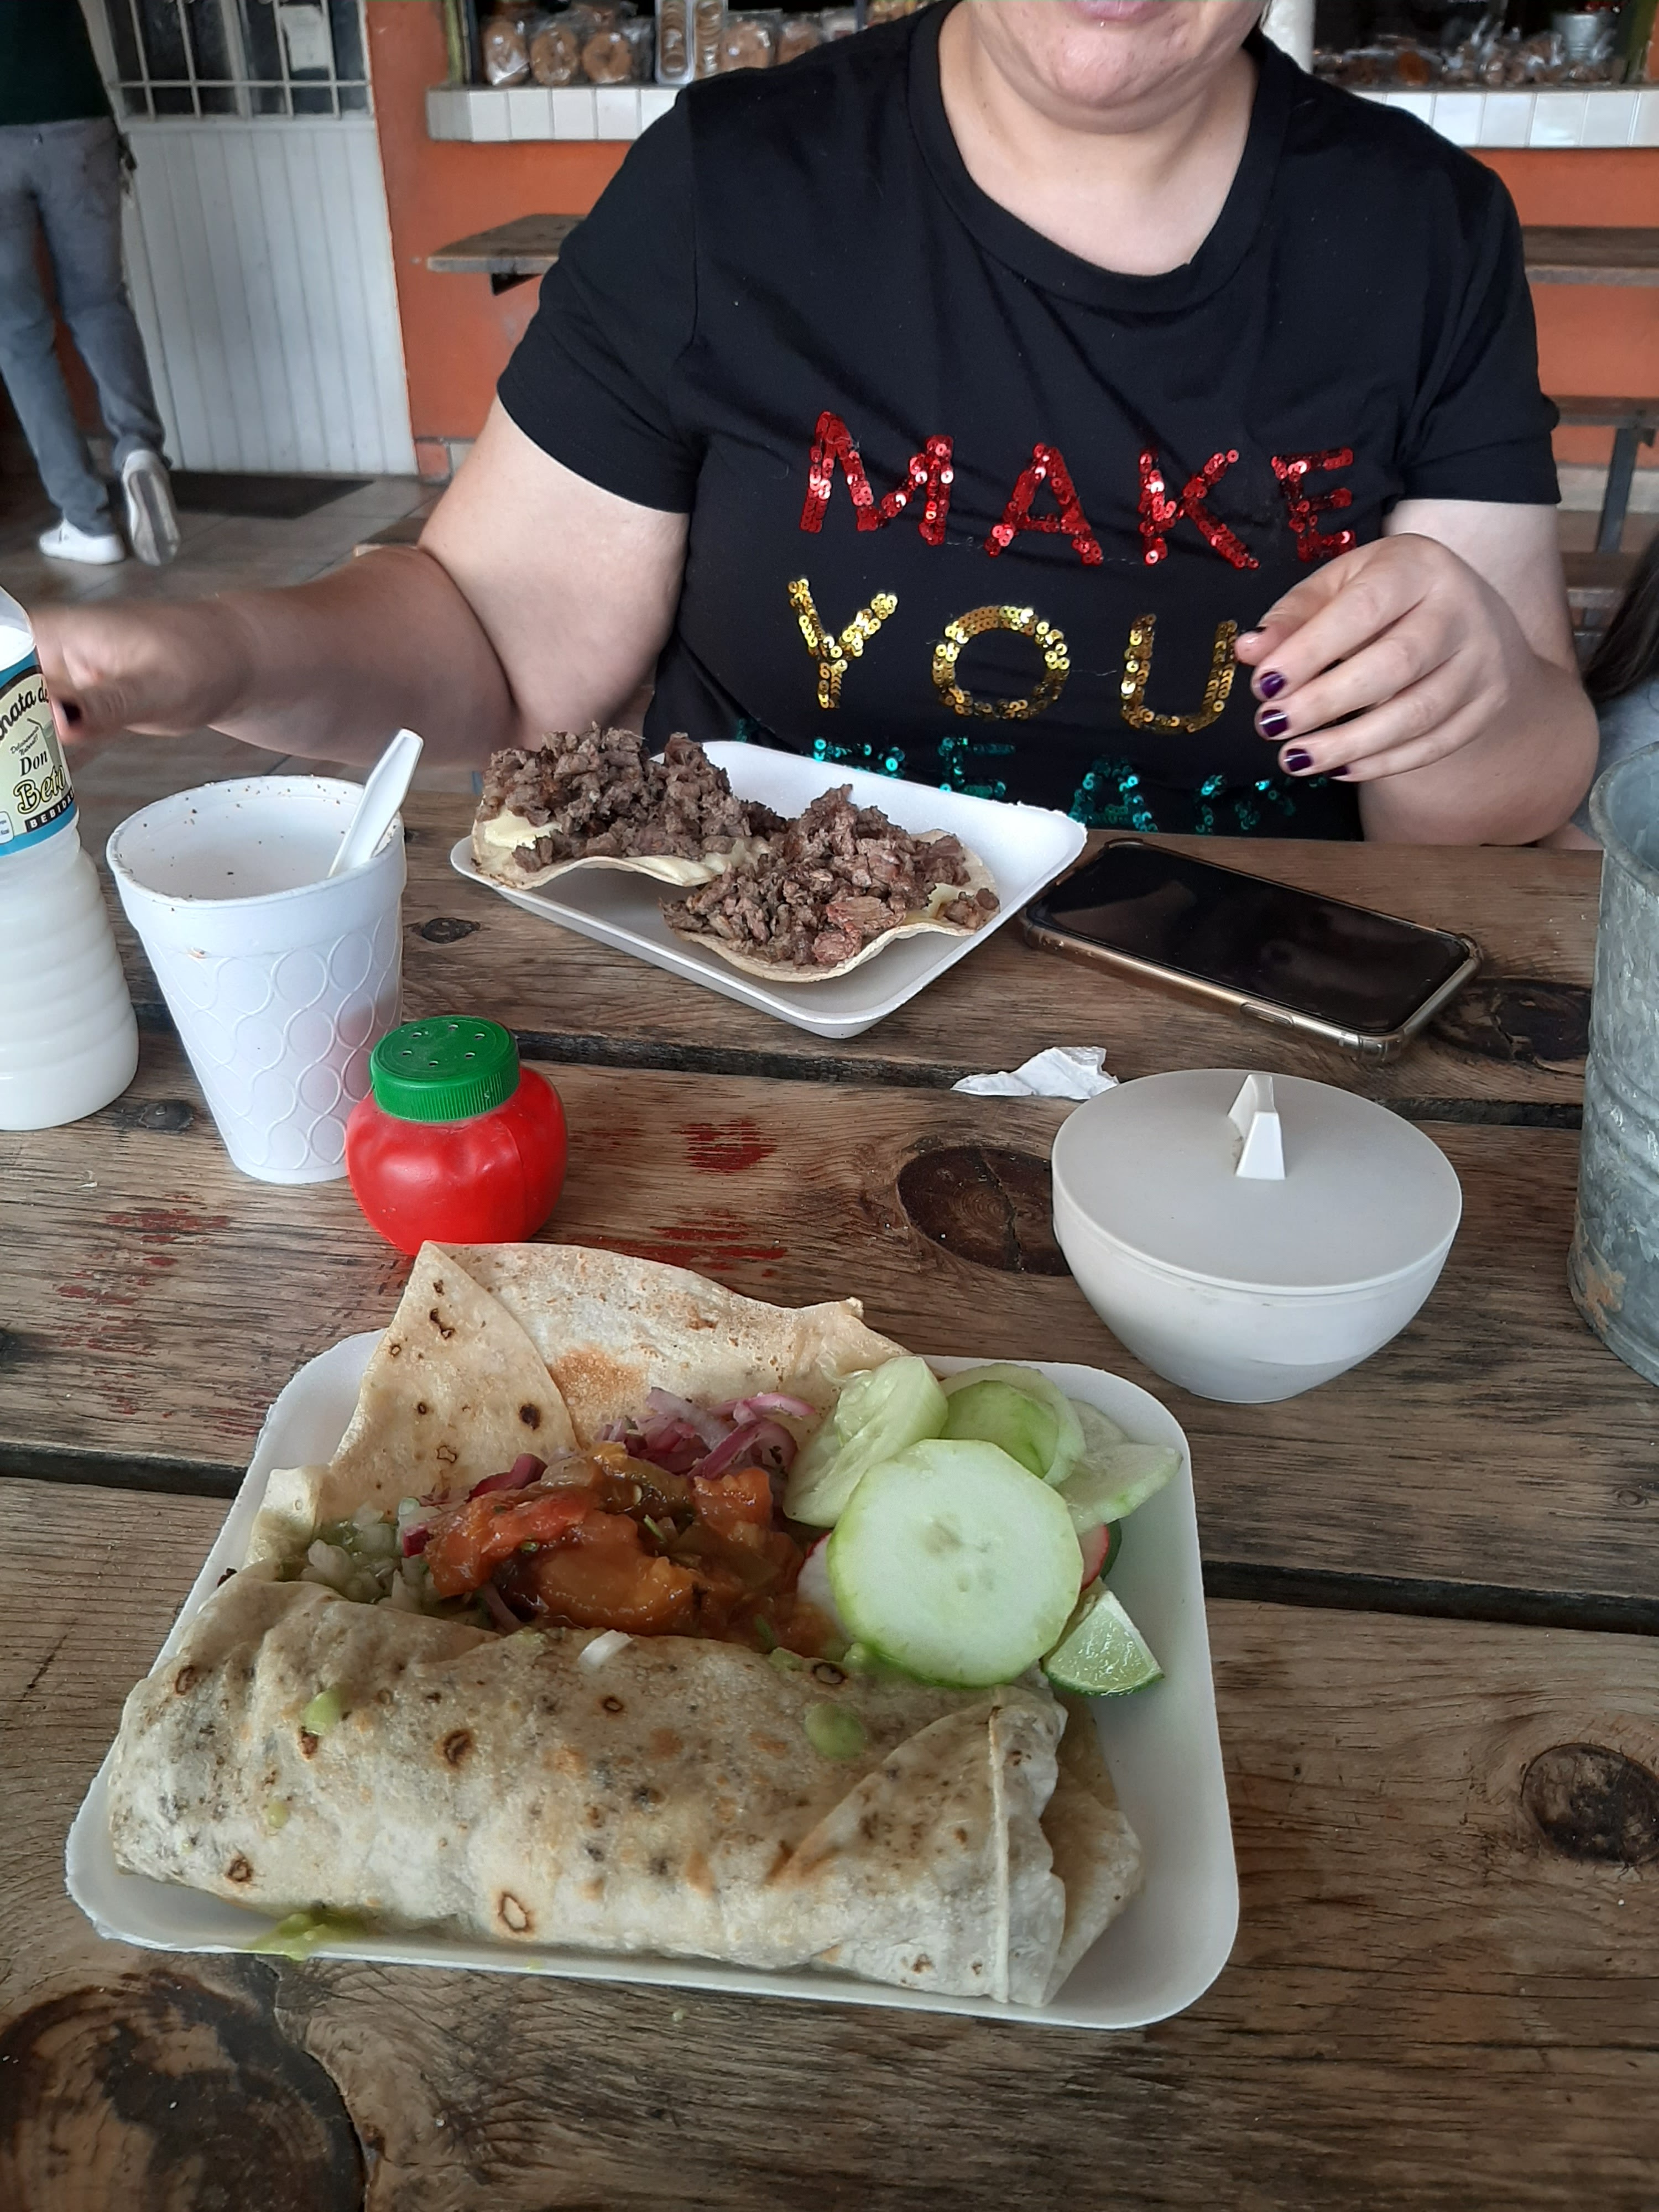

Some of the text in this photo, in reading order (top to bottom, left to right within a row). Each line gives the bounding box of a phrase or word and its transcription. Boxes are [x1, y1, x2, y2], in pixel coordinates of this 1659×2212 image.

[800, 411, 1358, 568] MAKE
[787, 577, 1239, 733] YOU
[19, 750, 48, 776] Don
[13, 765, 65, 814] Beto
[29, 789, 74, 829] BEBIDAS
